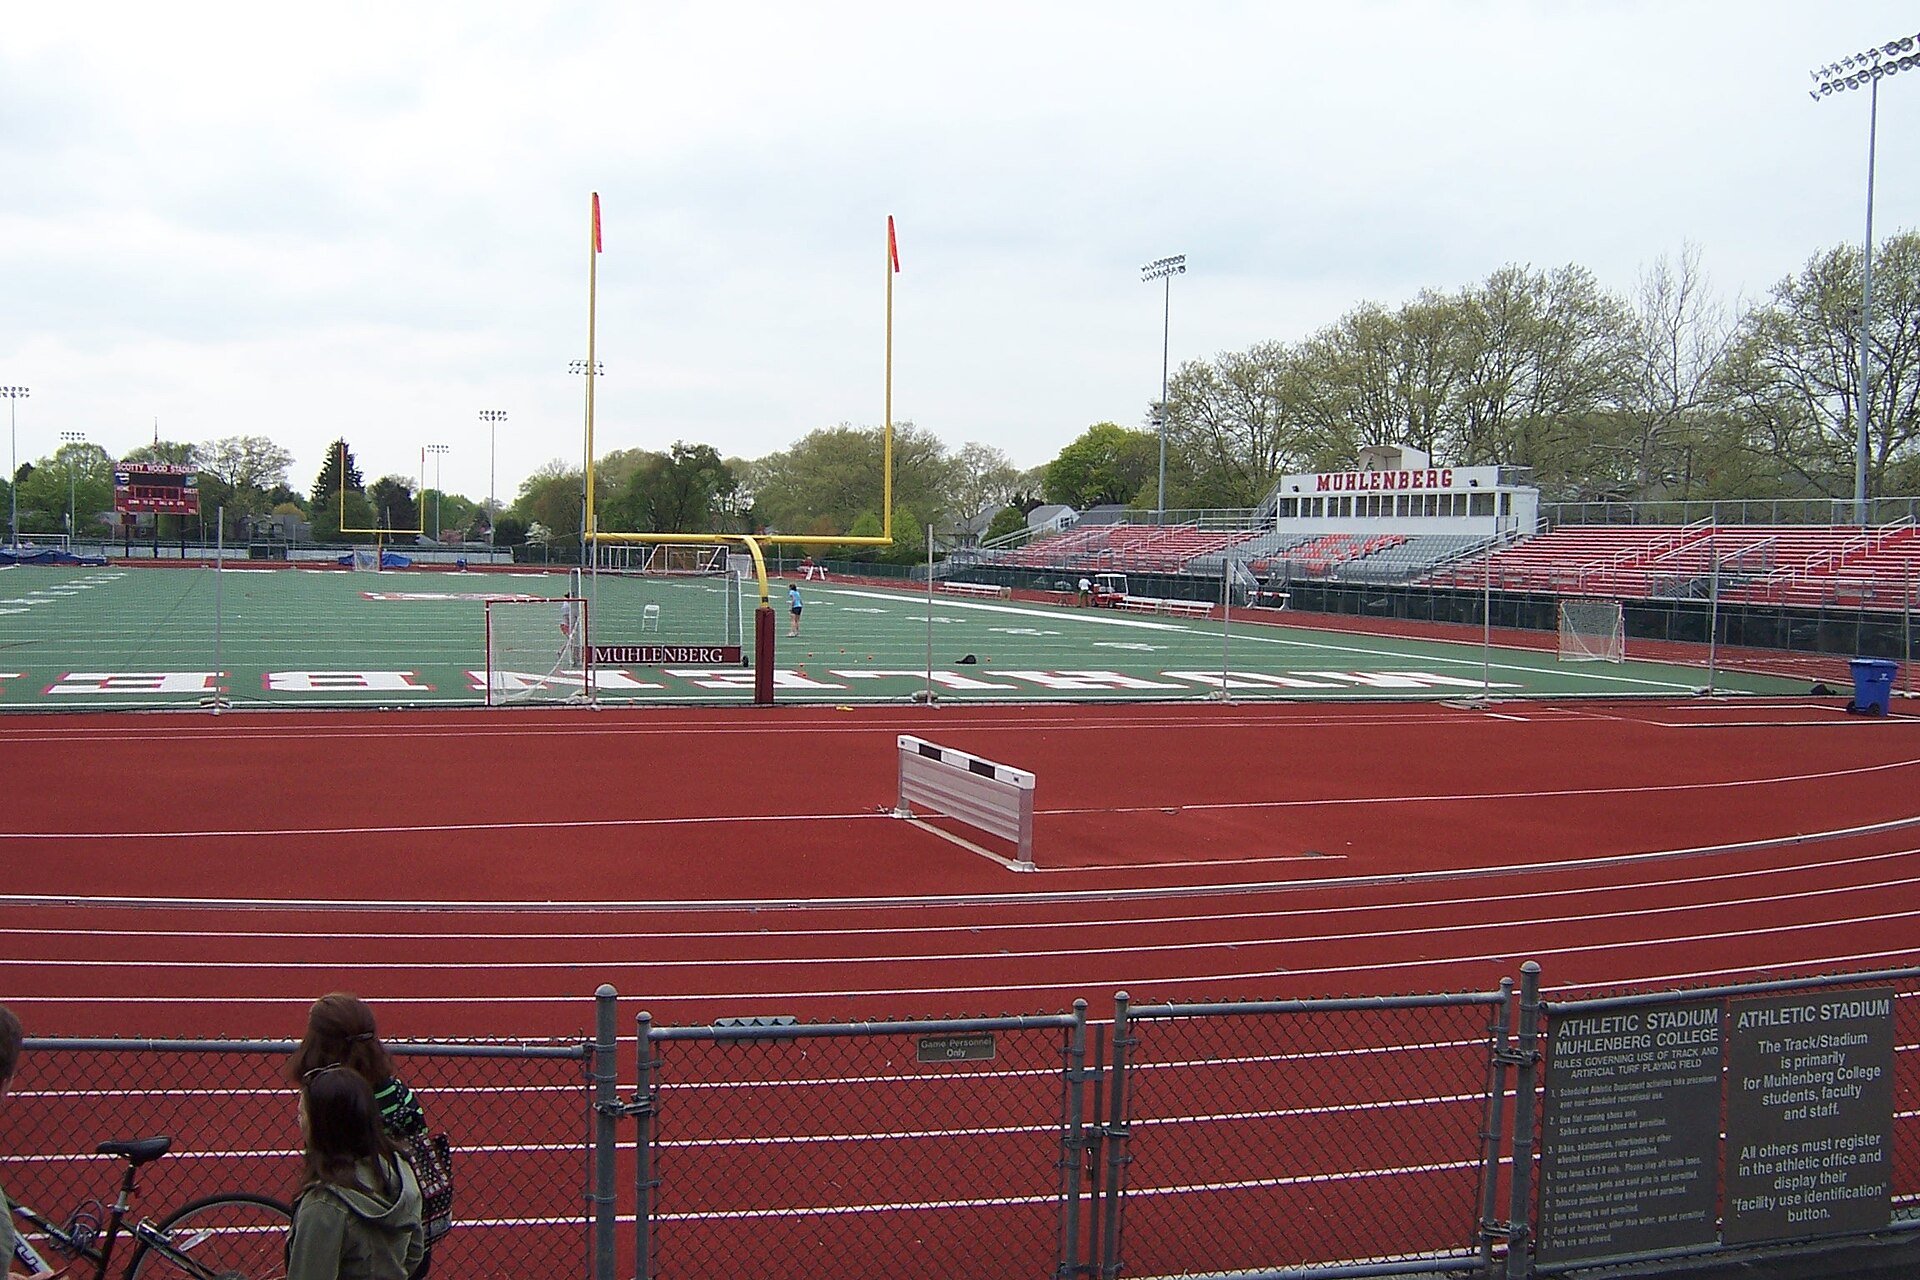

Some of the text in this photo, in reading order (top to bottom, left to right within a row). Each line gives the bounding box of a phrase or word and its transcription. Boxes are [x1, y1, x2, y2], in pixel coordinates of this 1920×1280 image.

[117, 463, 143, 472] SCOTTY
[170, 464, 198, 473] STADIUM
[1317, 469, 1453, 491] MUHLENBERG
[596, 648, 723, 662] MUHLENBERG
[1558, 1008, 1718, 1037] ATHLETIC STADIUM
[1738, 999, 1889, 1028] ATHLETIC STADIUM
[950, 1038, 991, 1046] Personnel
[1555, 1028, 1718, 1055] MUHLENBERG COLLEGE
[1758, 1033, 1868, 1054] The Track/Stadium
[947, 1049, 966, 1057] Only
[1554, 1047, 1718, 1069] RULES GOVERNING USE OF TRACK AND
[1781, 1051, 1845, 1070] is primarily
[1571, 1059, 1701, 1079] ARTIFICIAL TURF PLAYING FIELD
[1744, 1066, 1881, 1090] for Muhlenberg College
[1762, 1084, 1862, 1105] students, faculty
[1784, 1103, 1839, 1121] and staff.
[1740, 1134, 1880, 1160] All others must register
[1739, 1149, 1882, 1176] in the athletic office and
[1774, 1170, 1847, 1190] display their
[1732, 1182, 1886, 1211] "facility use identification"
[1788, 1208, 1830, 1222] button.
